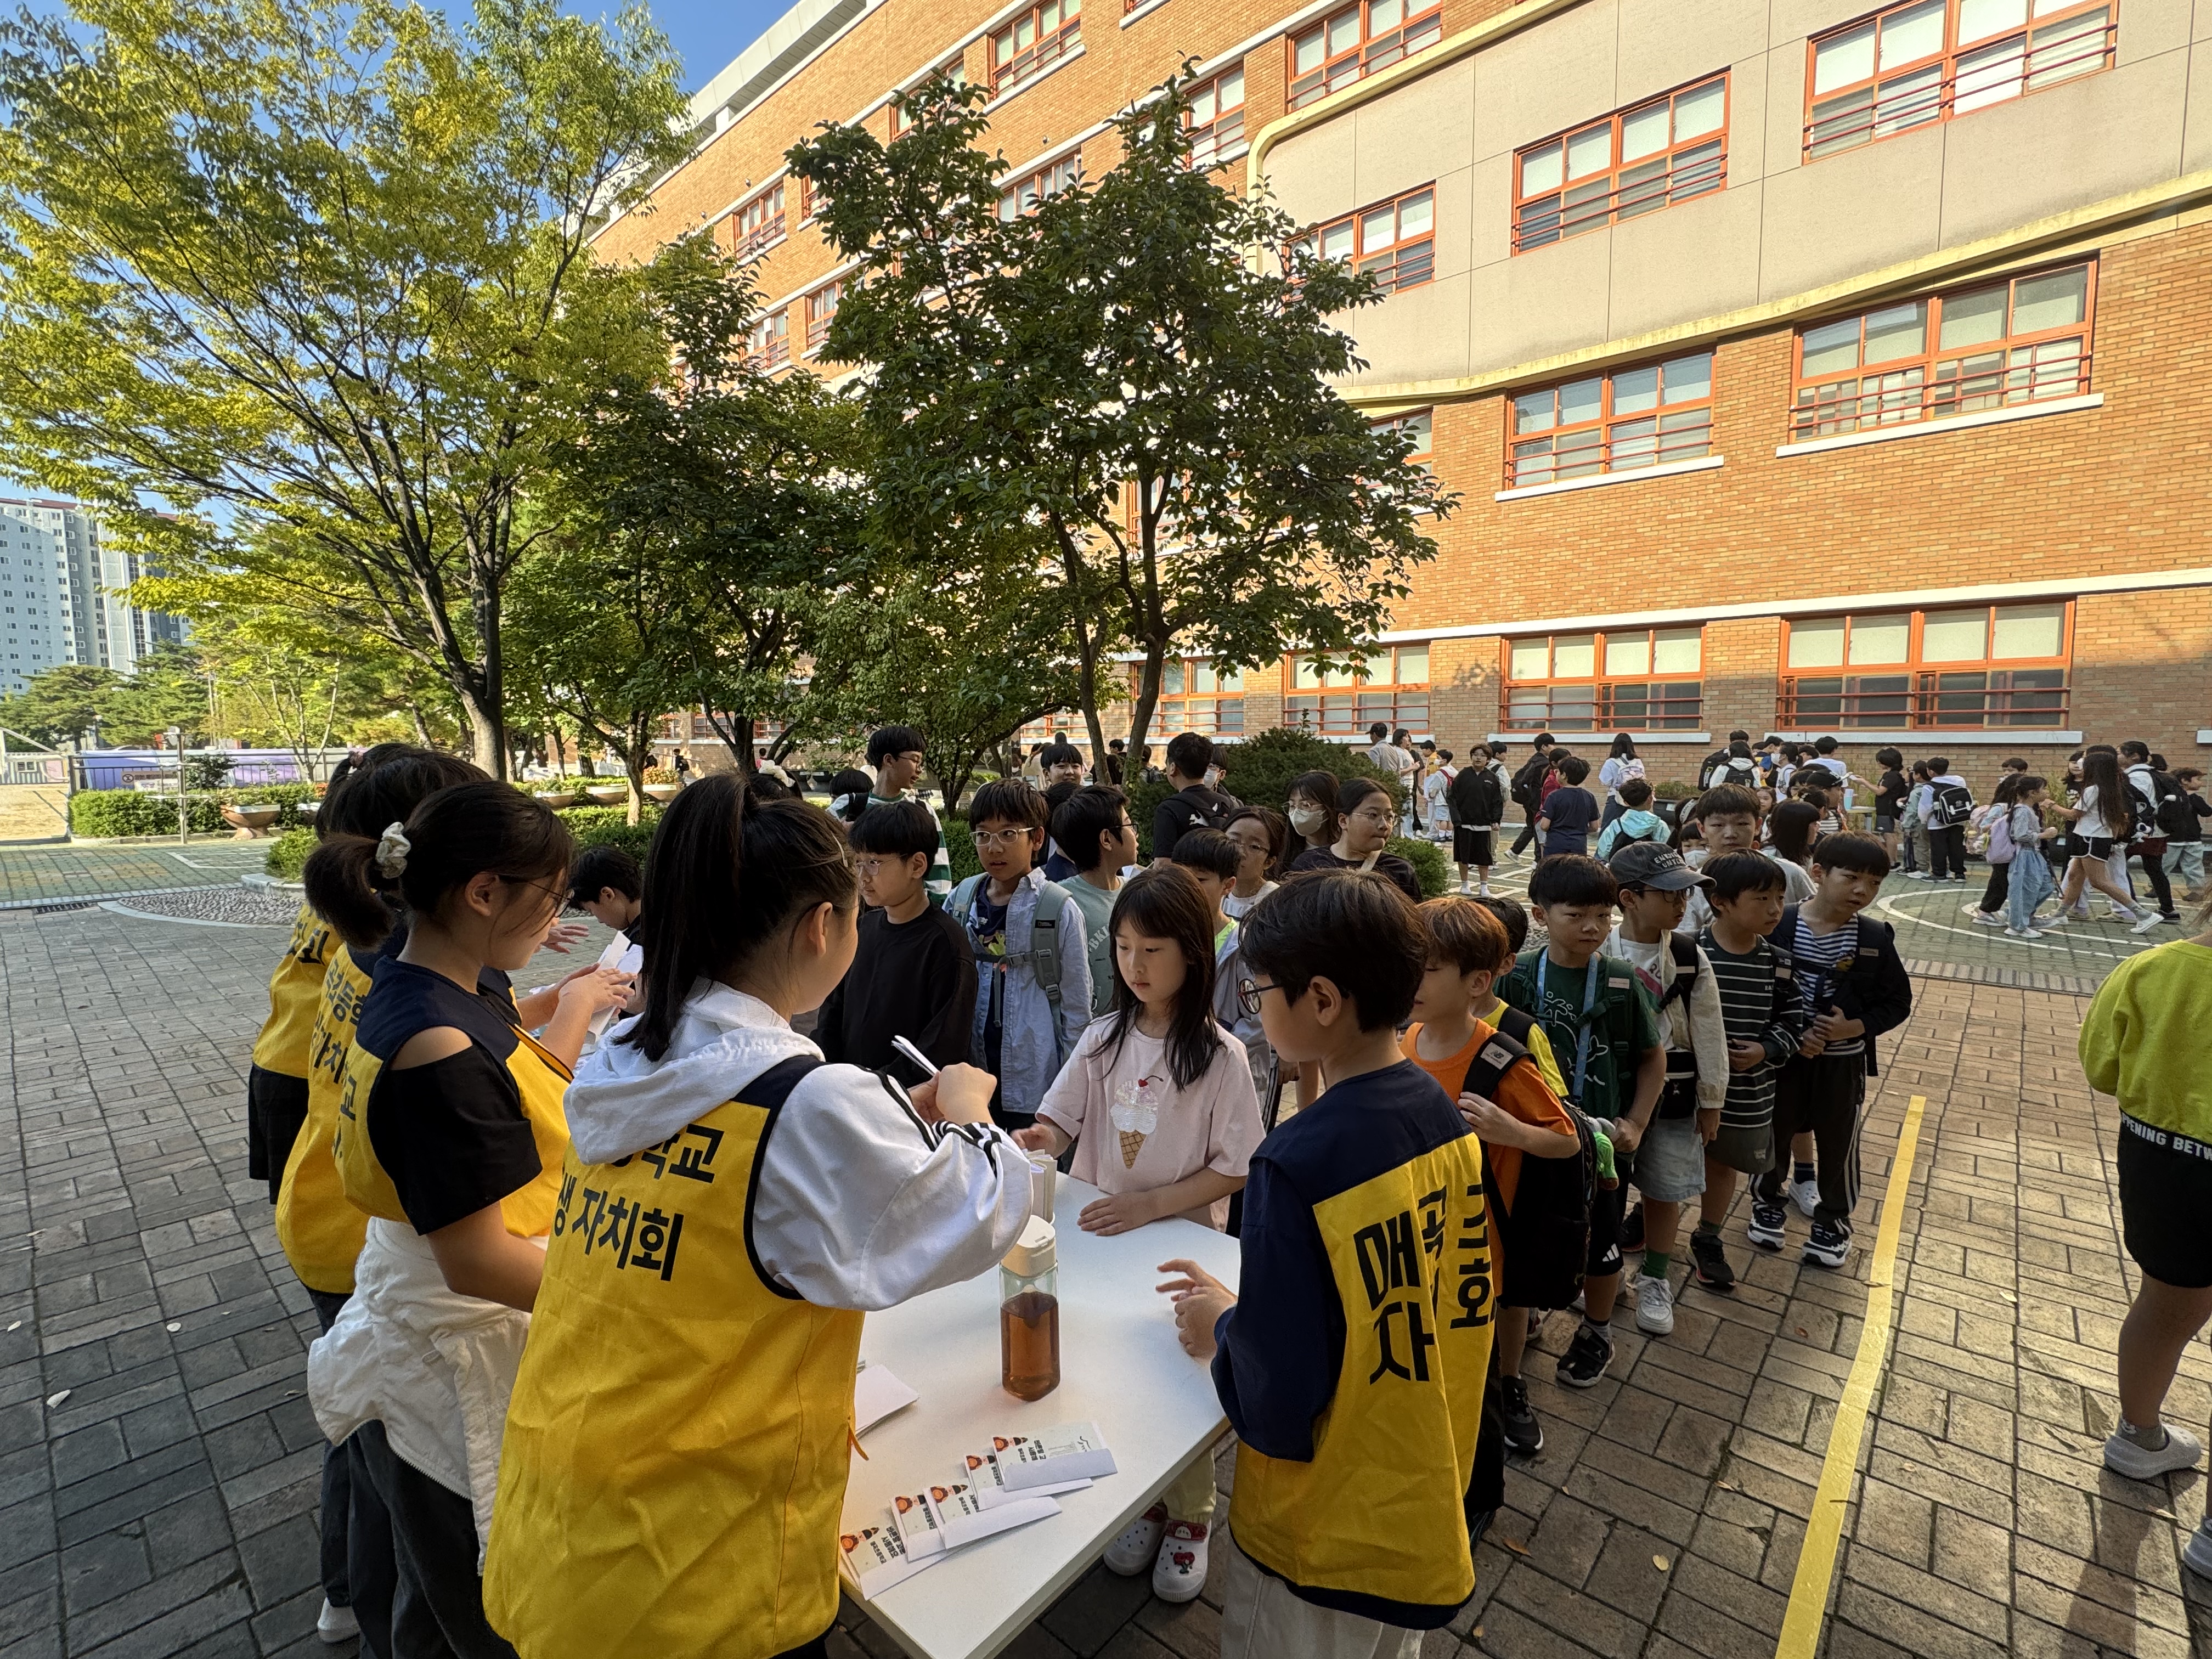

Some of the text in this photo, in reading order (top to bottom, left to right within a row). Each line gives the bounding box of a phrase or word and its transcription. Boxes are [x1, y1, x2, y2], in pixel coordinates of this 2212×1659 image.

[611, 1123, 725, 1184] 학교
[554, 1161, 685, 1282] 생 자치회
